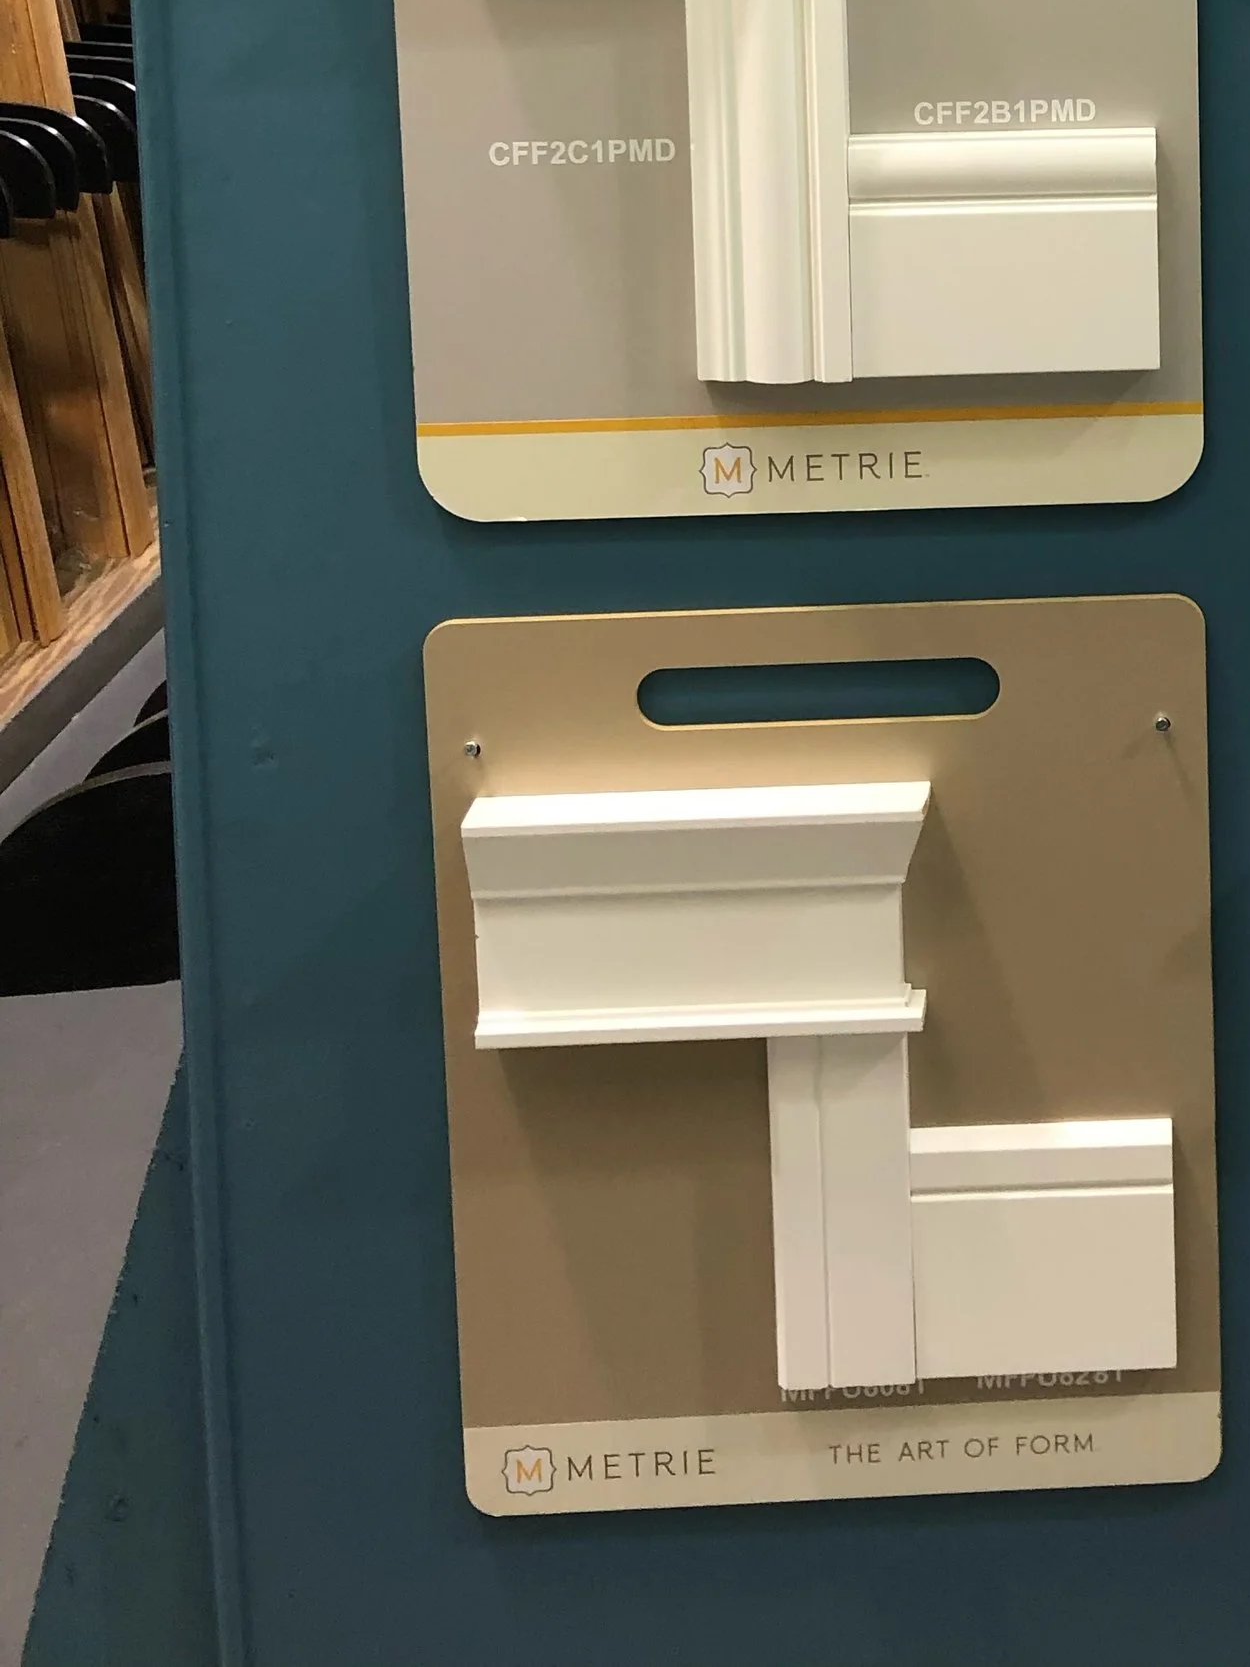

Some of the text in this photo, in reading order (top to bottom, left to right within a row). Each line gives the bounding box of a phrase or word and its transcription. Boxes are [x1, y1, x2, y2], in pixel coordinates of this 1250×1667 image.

[913, 98, 1096, 127] CFF2B1PMD
[488, 138, 676, 167] CFF2C1PMD
[714, 451, 922, 484] M METRIE
[829, 1434, 1094, 1465] THE ART OF FORM
[516, 1449, 717, 1484] M METRIE
